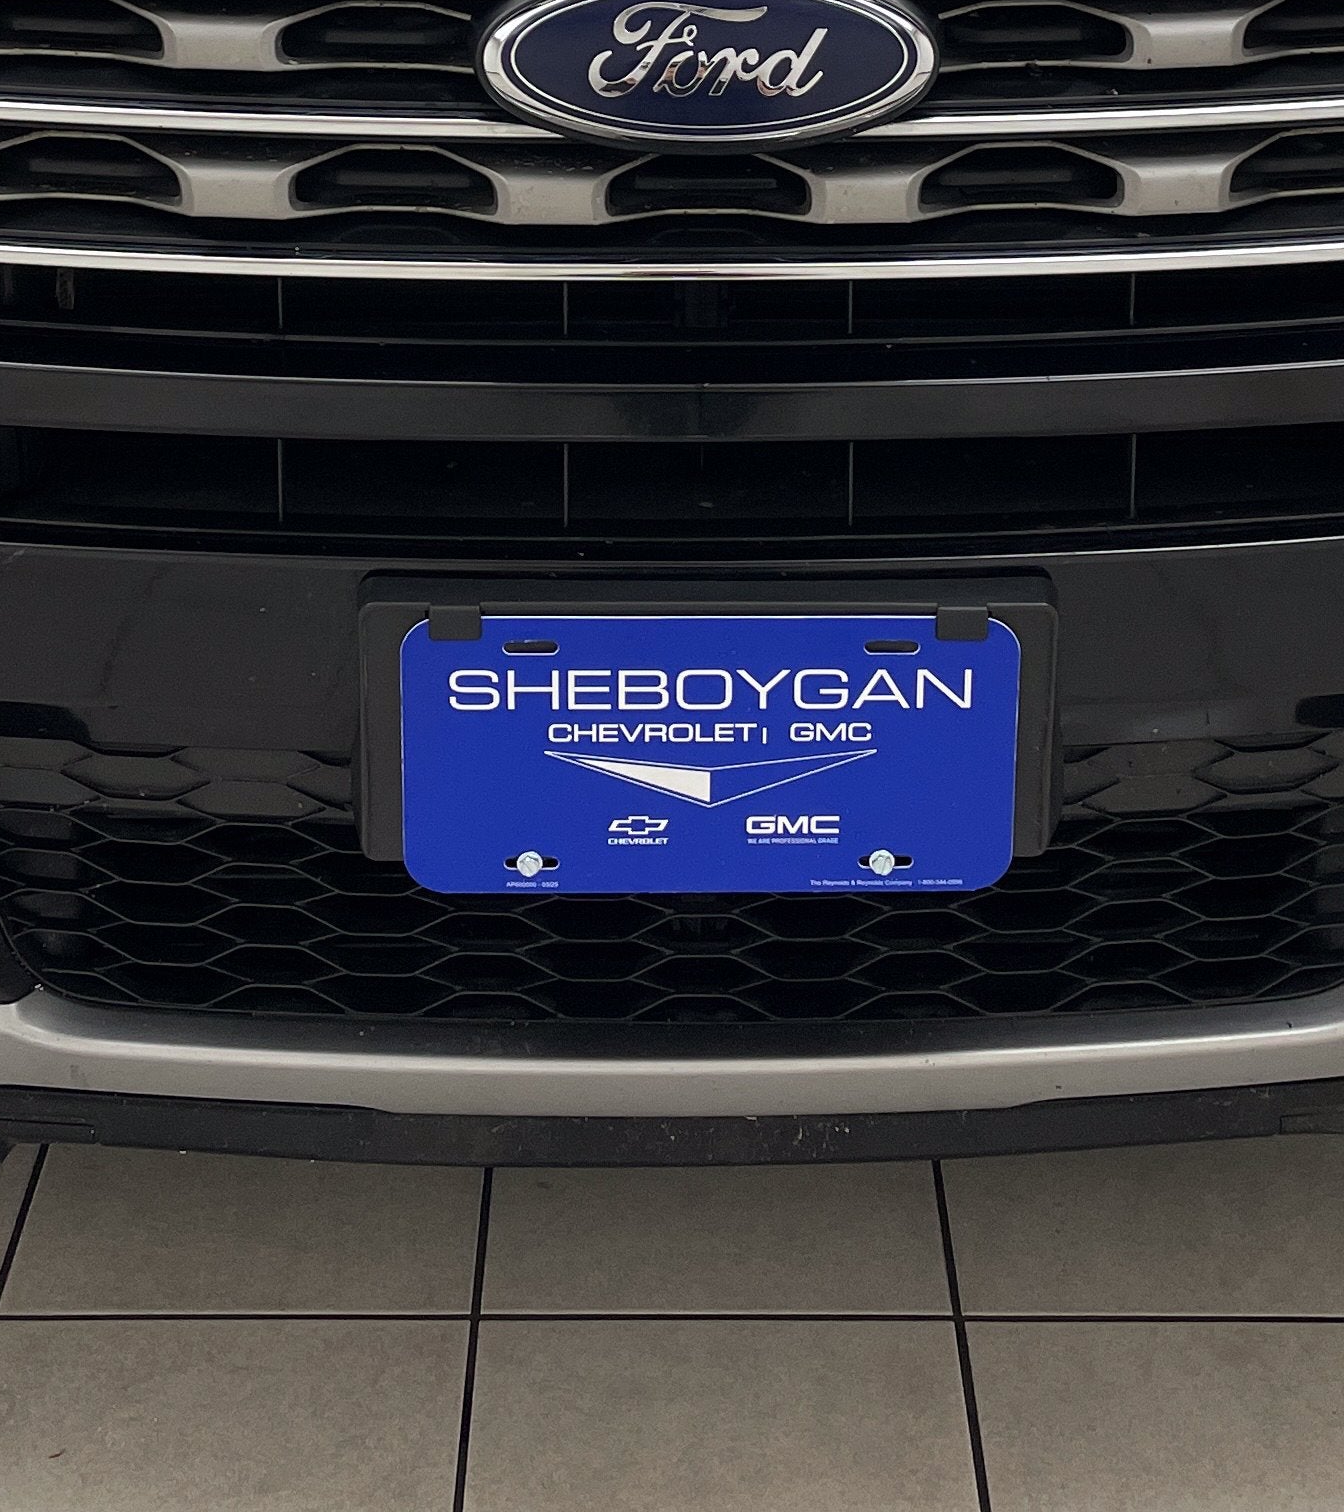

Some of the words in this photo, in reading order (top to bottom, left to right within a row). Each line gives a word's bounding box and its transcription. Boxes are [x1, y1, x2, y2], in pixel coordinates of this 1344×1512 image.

[587, 1, 829, 98] Ford
[448, 668, 973, 710] SHEBOYGAN
[548, 723, 758, 743] CHEVROLET
[789, 723, 872, 742] GMC
[746, 815, 840, 834] GMC
[607, 837, 669, 845] CHEVROLET
